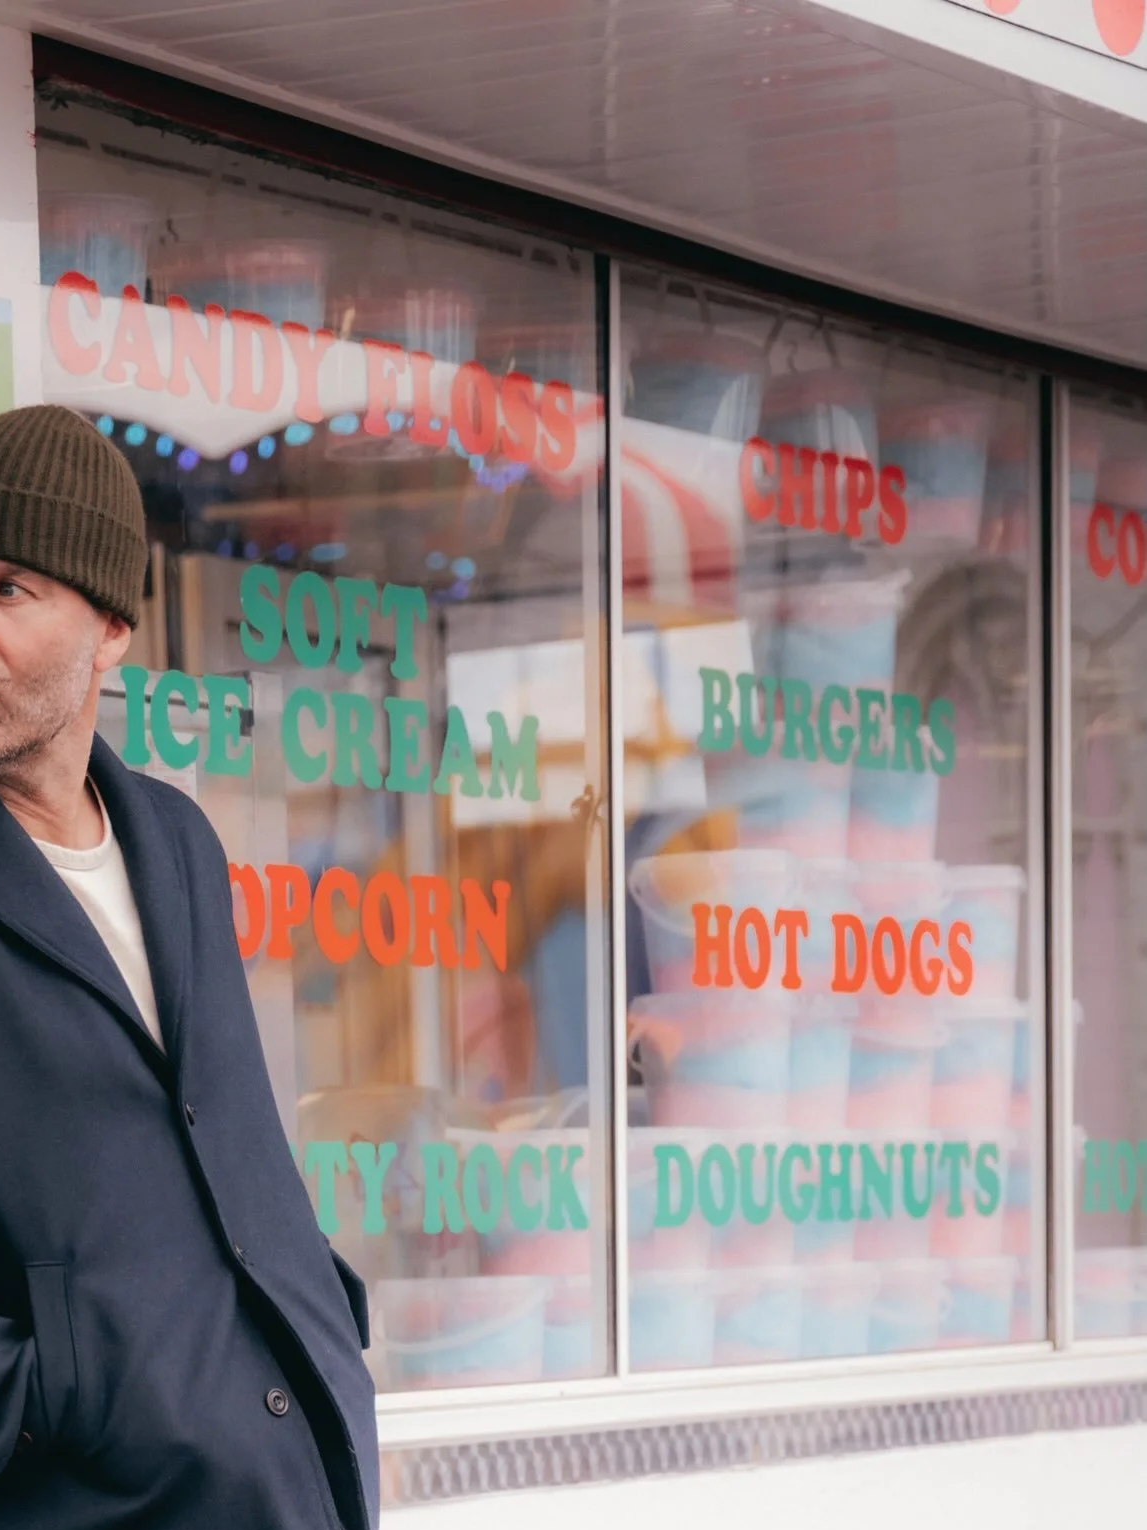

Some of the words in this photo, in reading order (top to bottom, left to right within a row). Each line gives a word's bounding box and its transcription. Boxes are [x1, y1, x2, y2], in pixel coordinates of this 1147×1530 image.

[48, 271, 335, 423] CANDY
[364, 339, 577, 472] FLOSS
[739, 437, 908, 545] CHIPS
[240, 564, 428, 681] SOFT
[119, 664, 252, 776] ICE
[280, 687, 540, 799] CREAM
[697, 666, 956, 777] BURGERS
[691, 902, 809, 990] HOT
[830, 912, 974, 996] DOGS
[289, 1140, 398, 1236] TY
[420, 1142, 590, 1236] ROCK
[652, 1142, 1002, 1228] DOUGHNUTS
